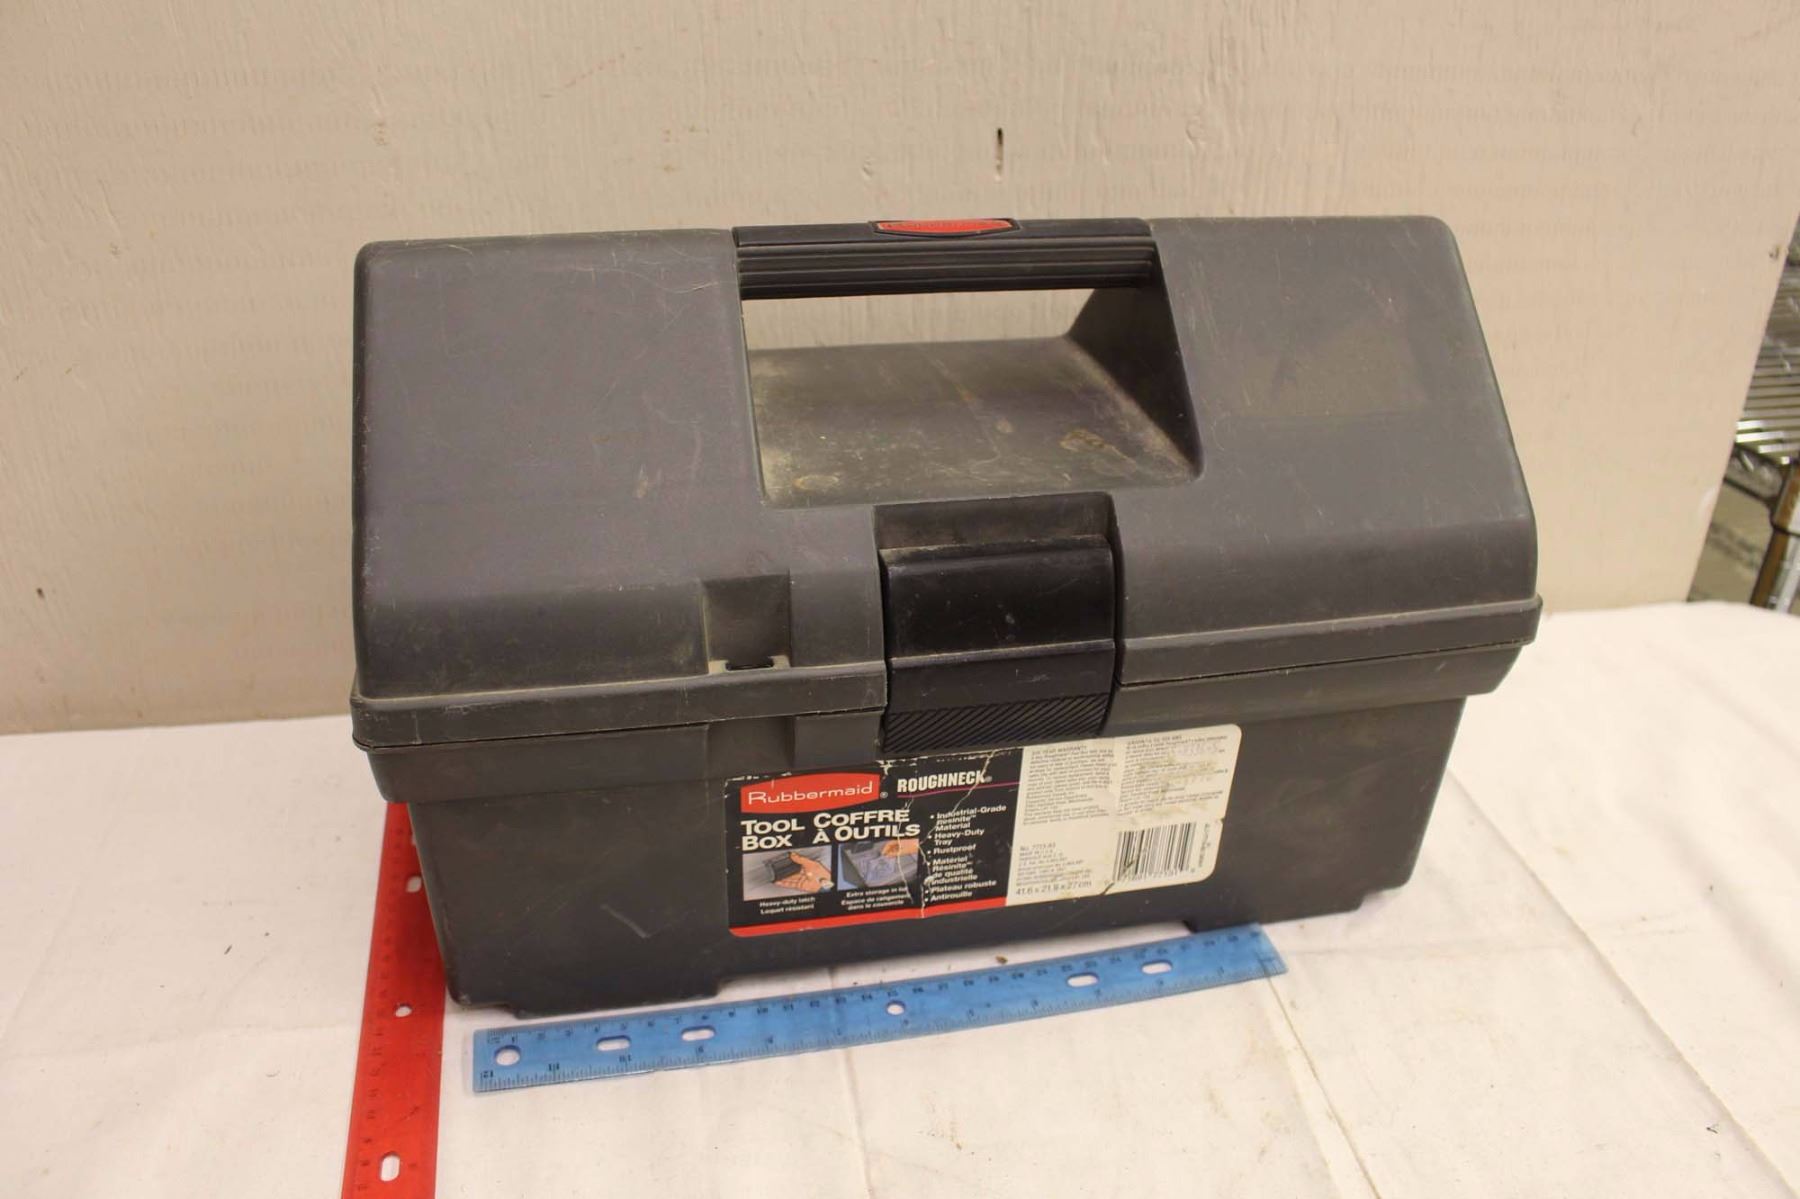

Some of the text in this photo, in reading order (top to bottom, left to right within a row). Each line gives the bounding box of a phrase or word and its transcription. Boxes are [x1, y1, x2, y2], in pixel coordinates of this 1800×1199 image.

[748, 781, 873, 805] Rubbermaid
[936, 804, 1007, 819] Industrial-Grade
[740, 818, 806, 836] TOOL
[813, 810, 910, 829] COFFRE
[936, 822, 970, 832] Material
[812, 824, 921, 844] À OUTILS
[934, 828, 985, 840] Heavy-Duty
[742, 834, 793, 851] BOX
[934, 844, 976, 854] Rustproof
[930, 880, 997, 893] Plateau robuste
[930, 890, 972, 902] Antirouille
